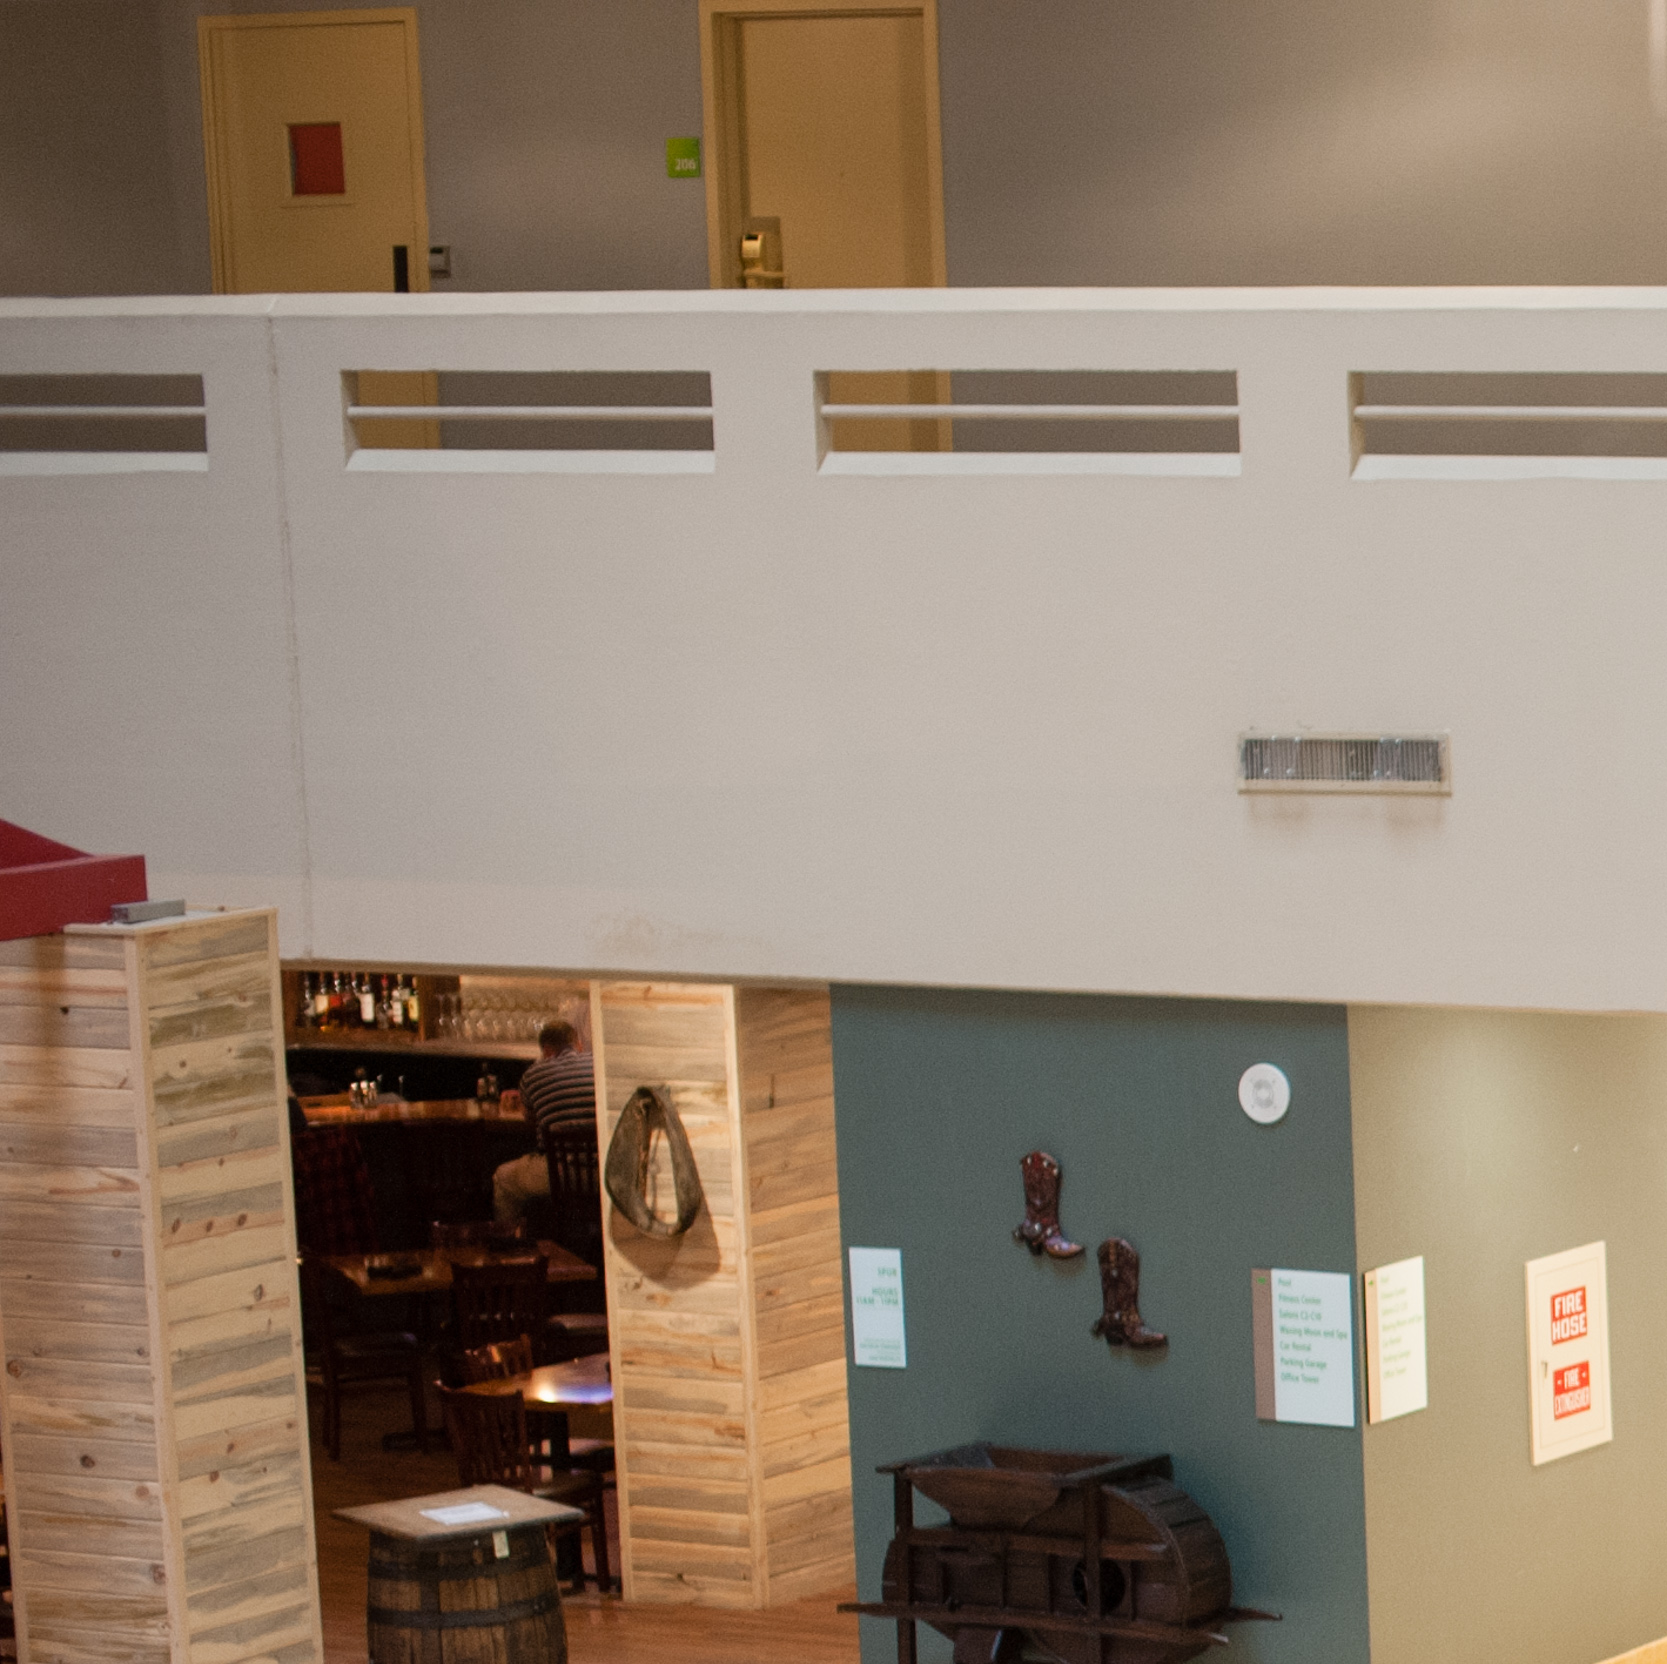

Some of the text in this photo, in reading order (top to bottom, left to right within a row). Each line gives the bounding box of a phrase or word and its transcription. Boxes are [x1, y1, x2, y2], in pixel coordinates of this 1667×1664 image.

[1555, 1290, 1583, 1318] FIRE
[1552, 1313, 1586, 1341] HOSE
[1564, 1368, 1580, 1389] FIRE
